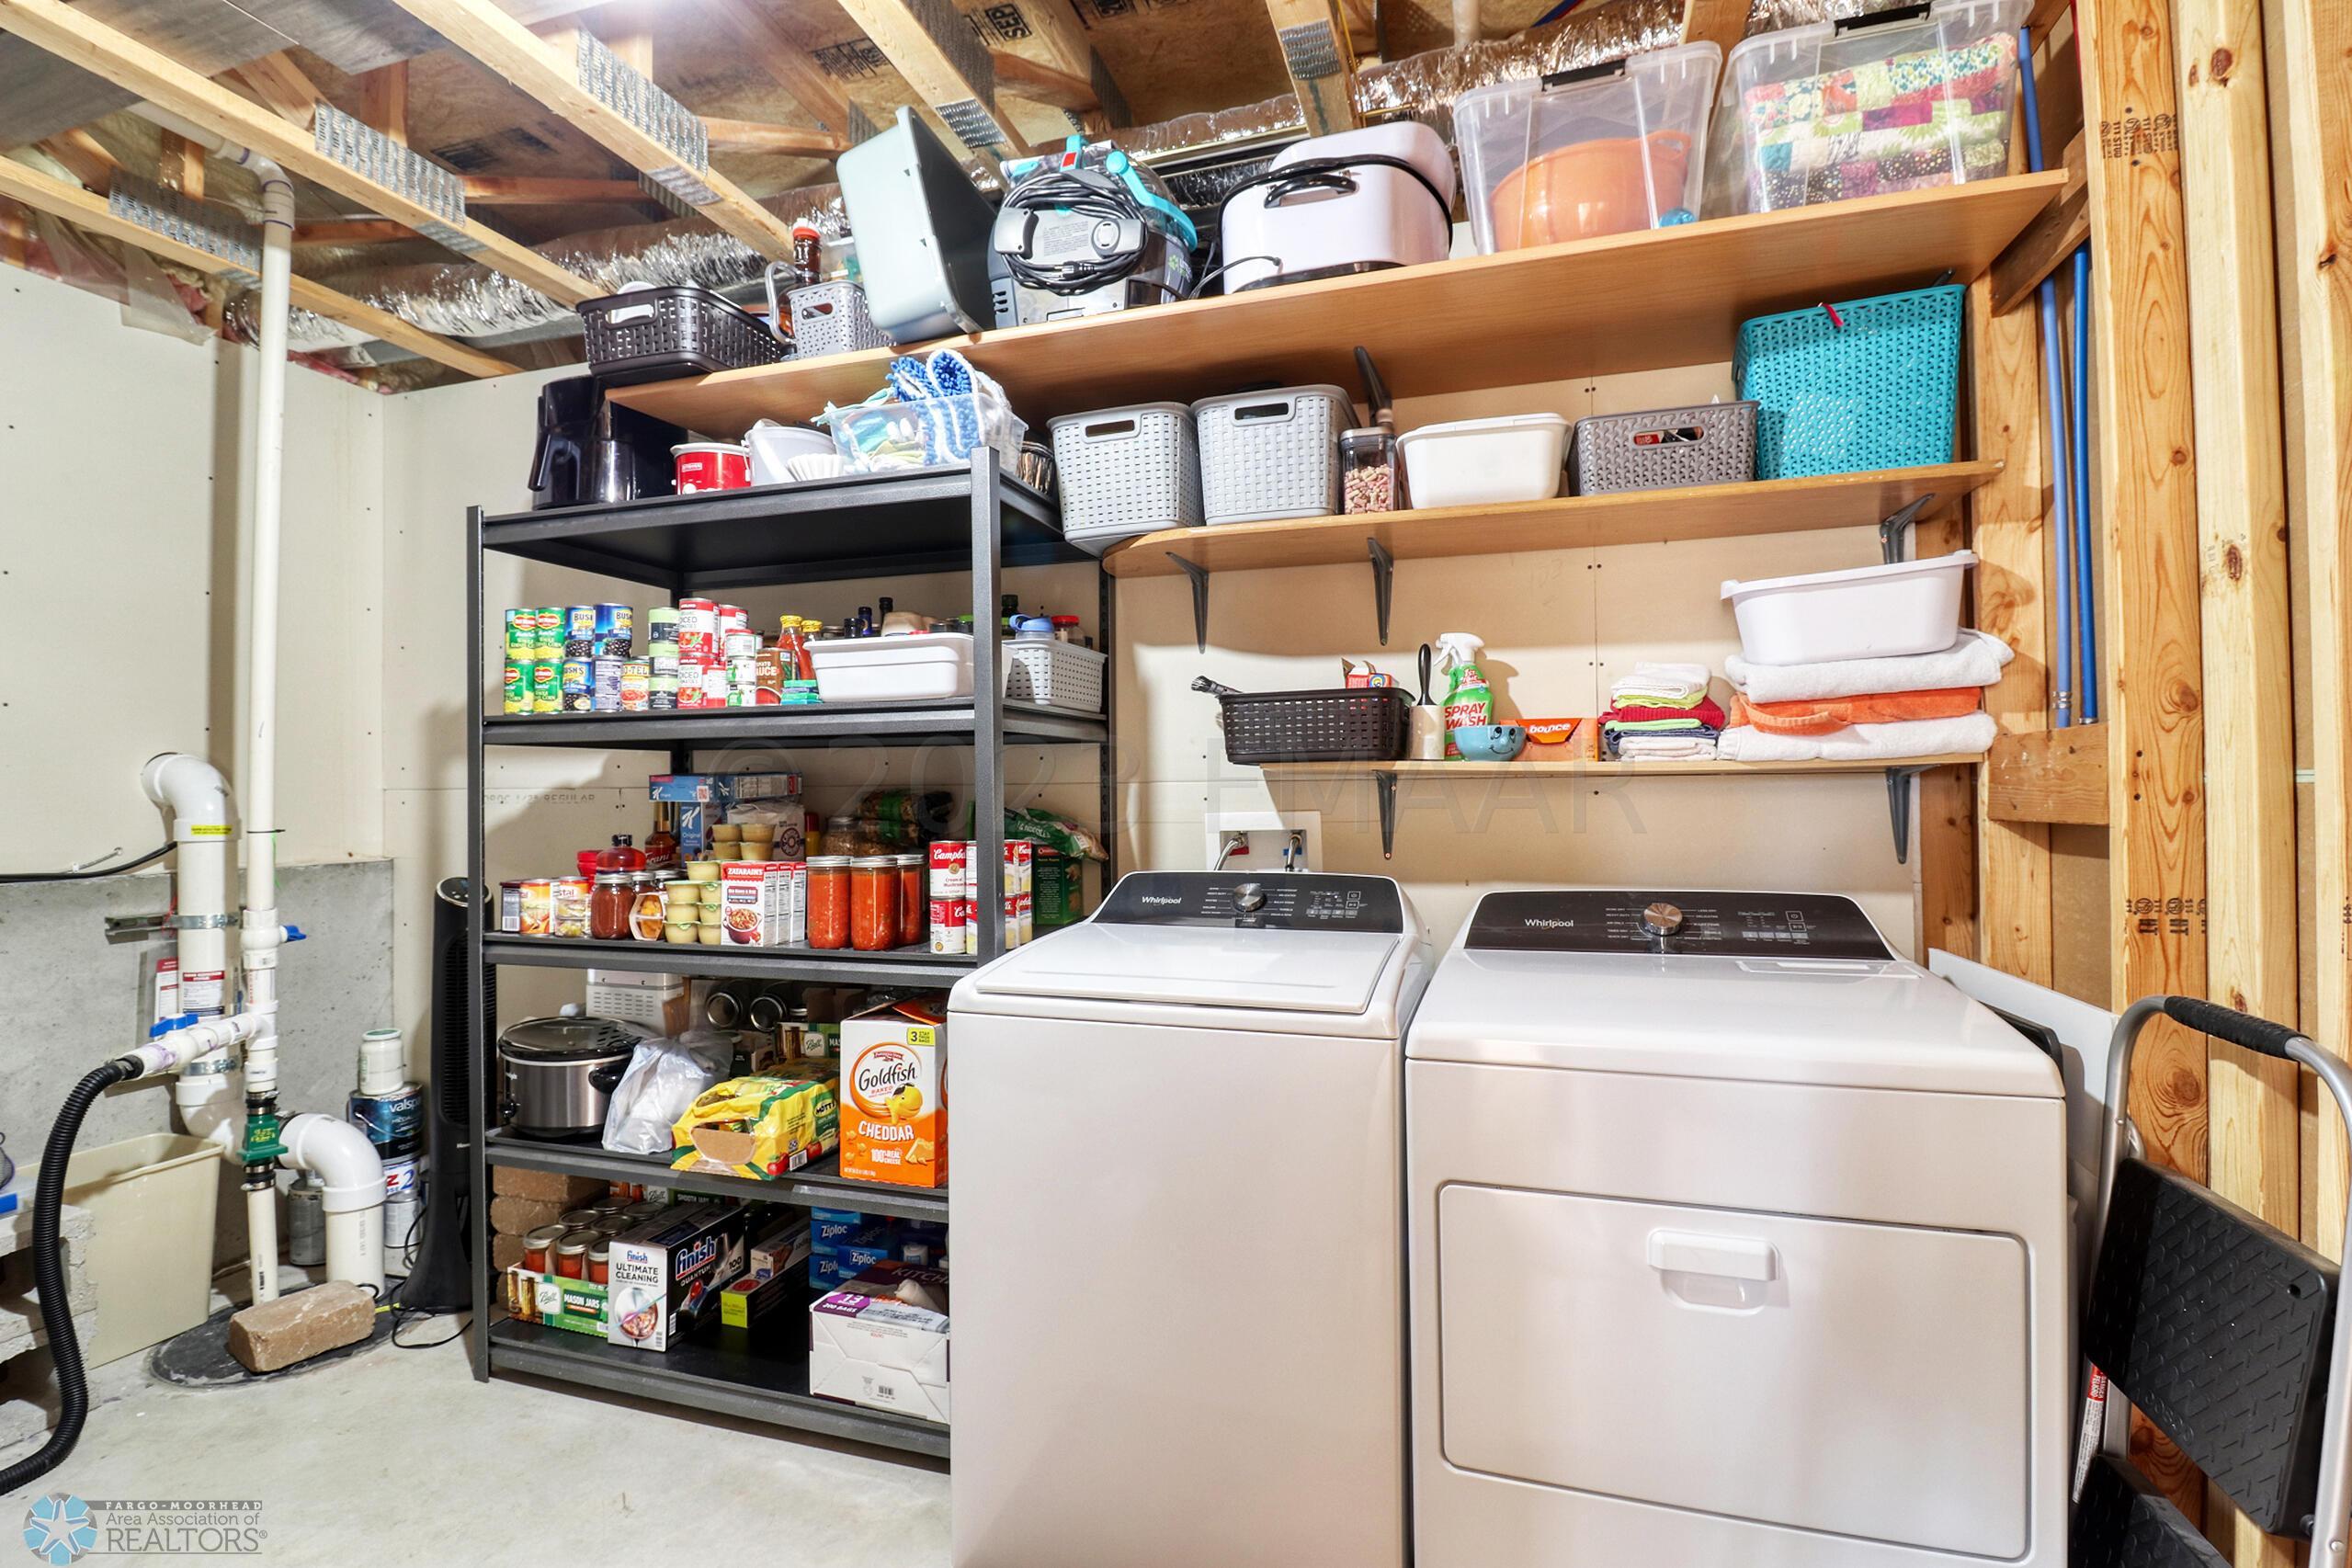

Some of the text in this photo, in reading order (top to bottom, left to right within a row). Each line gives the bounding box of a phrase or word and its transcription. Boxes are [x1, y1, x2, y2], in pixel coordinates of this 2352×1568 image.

[563, 666, 585, 676] USH'S
[756, 667, 778, 676] AUCE
[1444, 702, 1486, 718] SPRAY
[1445, 715, 1487, 731] WASH
[1528, 722, 1571, 734] bounce
[727, 867, 764, 877] ZATARAIN'S
[1142, 895, 1182, 906] Whirlpool
[1525, 918, 1574, 929] Whirlpool
[911, 1031, 917, 1041] 3
[805, 1038, 823, 1051] Ball
[858, 1062, 916, 1092] Goldfish
[858, 1119, 915, 1142] CHEDDAR
[403, 1168, 415, 1190] 2
[821, 1224, 847, 1238] Ziploc
[627, 1250, 648, 1263] finish
[675, 1235, 716, 1277] finish
[729, 1256, 743, 1269] 100
[851, 1251, 877, 1266] Ziploc
[615, 1262, 659, 1276] ULTIMATE
[615, 1271, 659, 1284] CLEANING
[680, 1265, 712, 1287] QUANTUM
[540, 1290, 558, 1305] Ball
[563, 1293, 600, 1310] MASON JARS
[842, 1293, 865, 1304] 13
